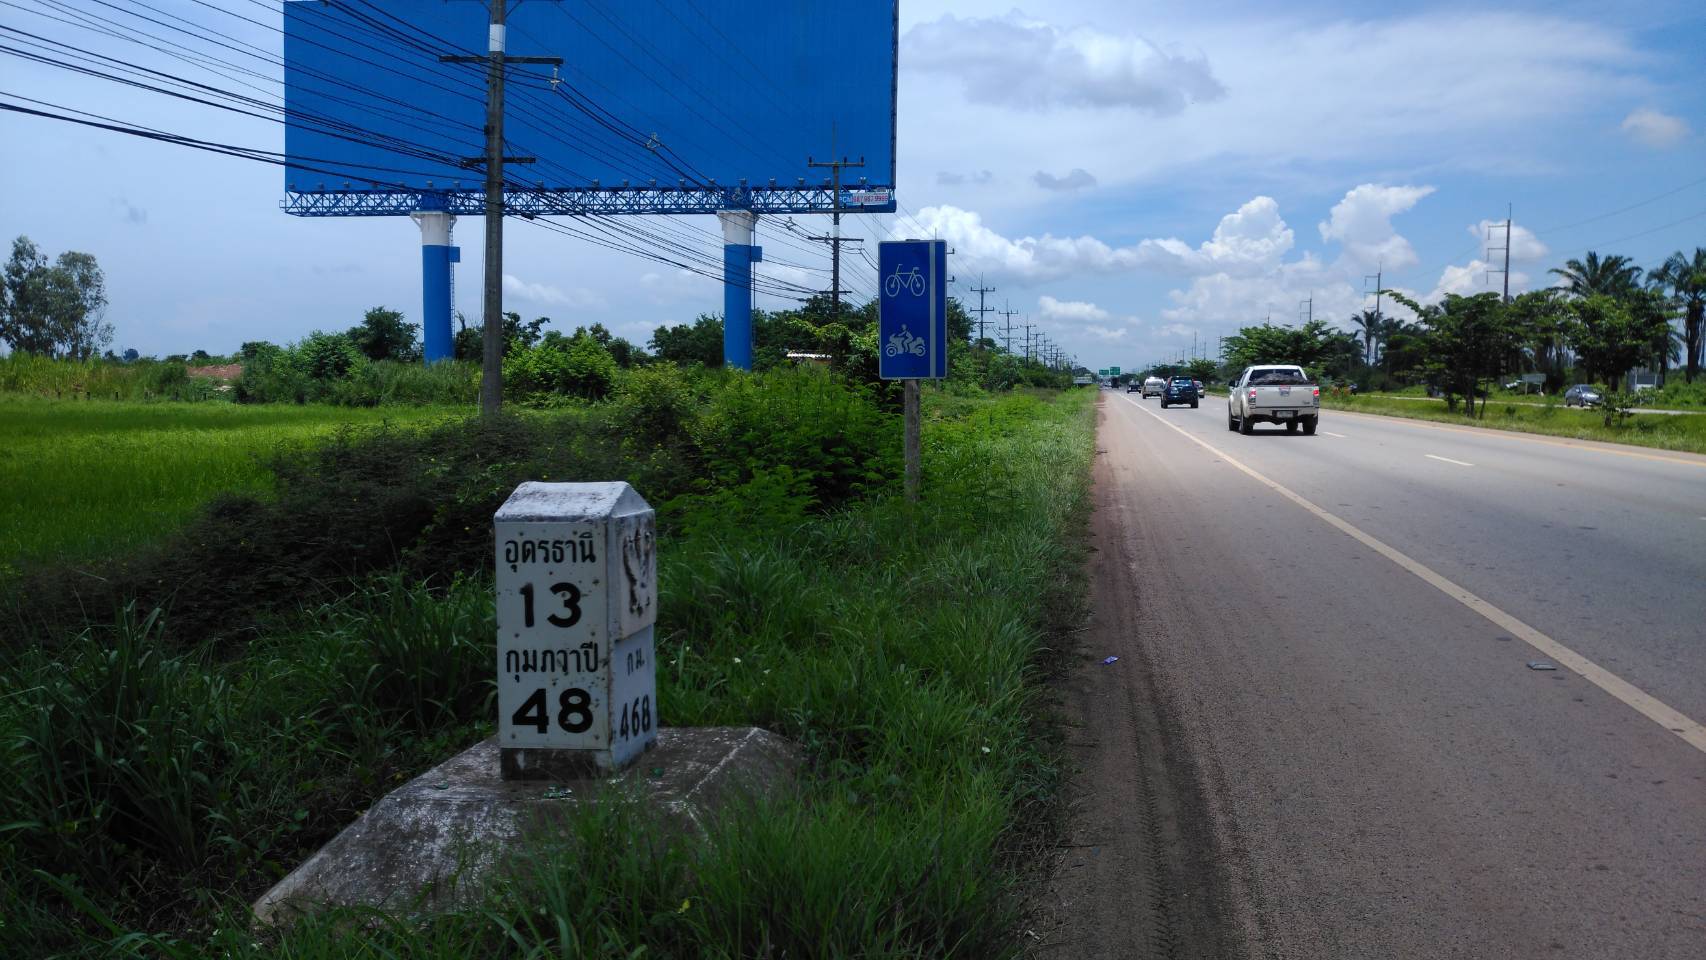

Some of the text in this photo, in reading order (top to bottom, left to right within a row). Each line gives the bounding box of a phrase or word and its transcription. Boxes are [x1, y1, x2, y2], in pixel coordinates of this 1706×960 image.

[519, 582, 582, 628] 13
[505, 641, 599, 683] กุมภวาปี
[512, 687, 594, 734] 48
[620, 694, 651, 742] 468
